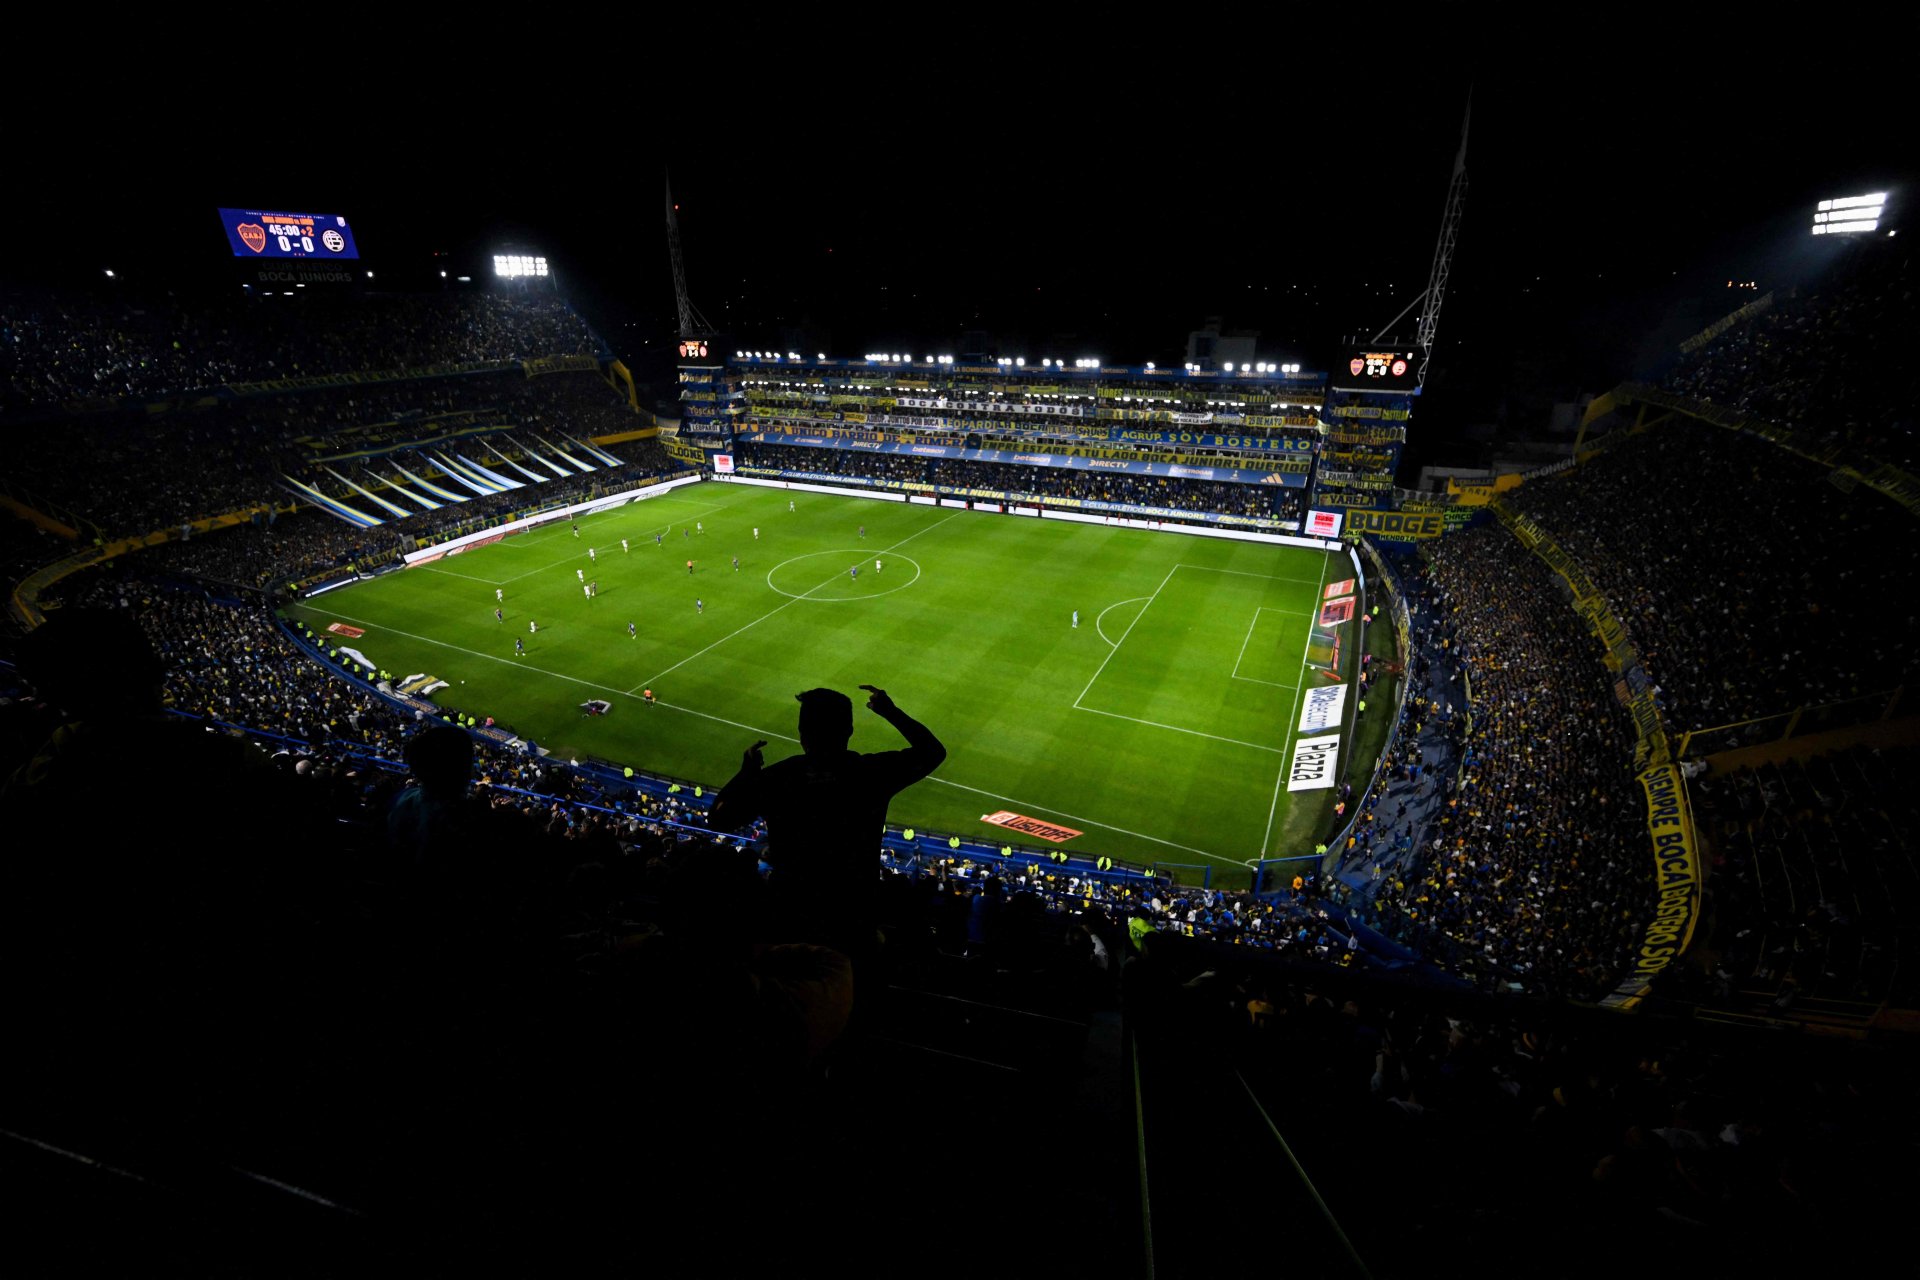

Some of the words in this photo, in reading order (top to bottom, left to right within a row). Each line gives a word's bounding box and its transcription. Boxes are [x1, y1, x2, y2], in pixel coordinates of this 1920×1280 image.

[269, 224, 301, 236] 45:00
[278, 236, 291, 252] 0
[301, 236, 314, 253] 0
[258, 271, 295, 282] BOCA
[299, 272, 353, 283] JUNIORS
[898, 399, 939, 408] BOCA
[946, 401, 1015, 411] CONTRA
[1022, 405, 1080, 417] TODOS
[942, 418, 998, 430] LEOPARDI
[1264, 417, 1282, 426] MAYO
[758, 425, 786, 434] BOCA
[791, 426, 828, 437] UNICO
[832, 428, 878, 441] BARRIO
[1121, 431, 1163, 443] AGRUP.
[1169, 433, 1204, 444] SOY
[1214, 436, 1310, 450] BOSTERO
[912, 446, 947, 455] betsson
[1022, 443, 1068, 456] ESTARE
[1071, 447, 1081, 457] A
[1085, 448, 1099, 458] TU
[1103, 449, 1139, 461] LADO
[1141, 452, 1179, 464] BOCA
[1181, 455, 1241, 468] JUNIORS
[1245, 458, 1310, 473] QUERIDO
[1089, 459, 1129, 469] DIRECTV
[887, 480, 900, 489] LA
[902, 481, 935, 492] NUEVA
[953, 487, 966, 496] LA
[969, 488, 1006, 500] NUEVA
[1026, 494, 1040, 504] LA
[1043, 496, 1082, 508] NUEVA
[1330, 495, 1375, 505] VARELA
[1088, 502, 1108, 511] CLUB
[1146, 506, 1165, 515] BOCA
[1166, 508, 1205, 520] JUNIORS
[1443, 512, 1472, 520] CHACO
[1350, 512, 1440, 536] BUDGE
[1292, 742, 1338, 782] Piazza
[1643, 766, 1681, 828] SIEMPRE
[1656, 831, 1692, 885] BOCA
[1645, 885, 1692, 945] BOSTERO
[1635, 942, 1678, 975] SOY
